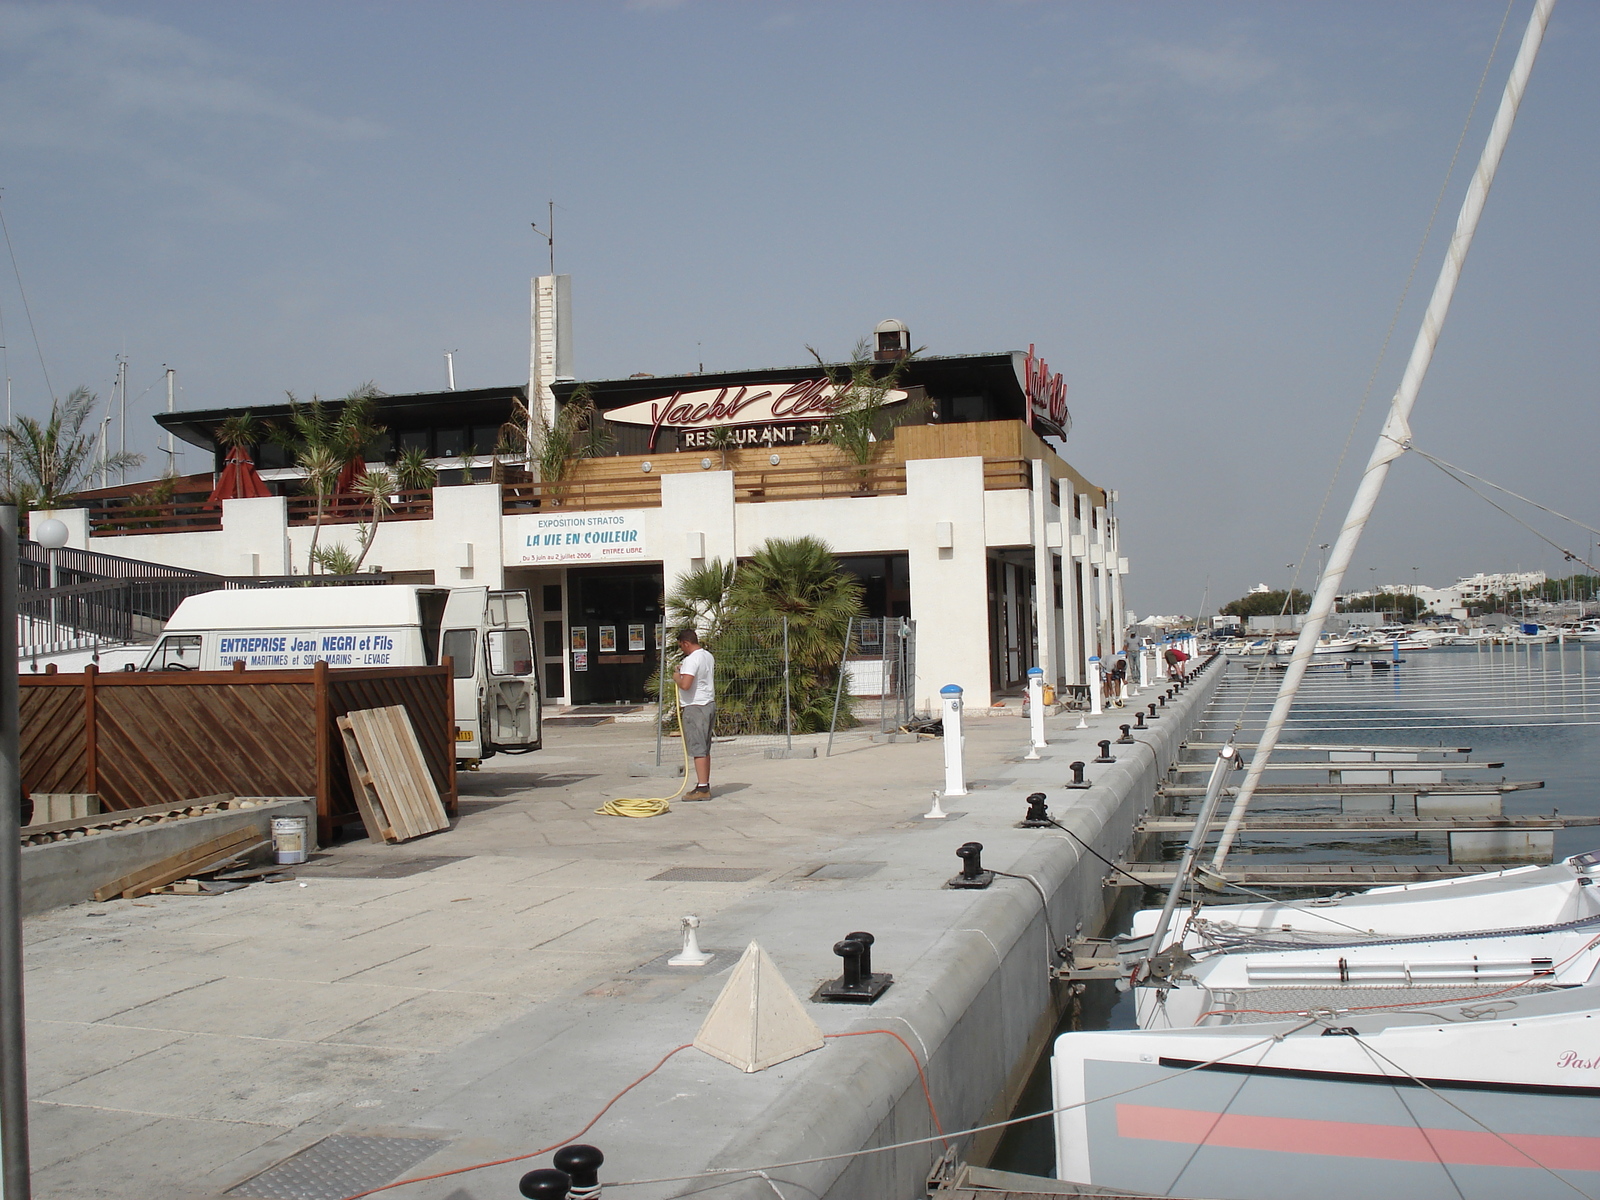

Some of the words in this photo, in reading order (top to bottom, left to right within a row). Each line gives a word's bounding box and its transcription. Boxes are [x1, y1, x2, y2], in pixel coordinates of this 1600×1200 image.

[648, 386, 773, 449] Yacht
[685, 426, 796, 447] RESAURANT
[538, 518, 585, 528] EXPOSITION
[587, 516, 625, 526] STRATOS
[526, 534, 540, 547] LA
[544, 533, 562, 546] VIE
[565, 532, 581, 545] EN
[584, 529, 638, 544] COULEUR
[560, 552, 576, 562] juillet
[220, 637, 287, 653] ENTREPRISE
[291, 637, 317, 652] Jean
[322, 636, 357, 651] NEGRI
[359, 636, 371, 651] et
[373, 635, 393, 651] Fils
[251, 654, 289, 666] MARITIMES
[292, 655, 299, 666] et
[303, 654, 322, 665] SOUS
[325, 653, 352, 665] MARINS
[364, 653, 390, 665] LEVAGE
